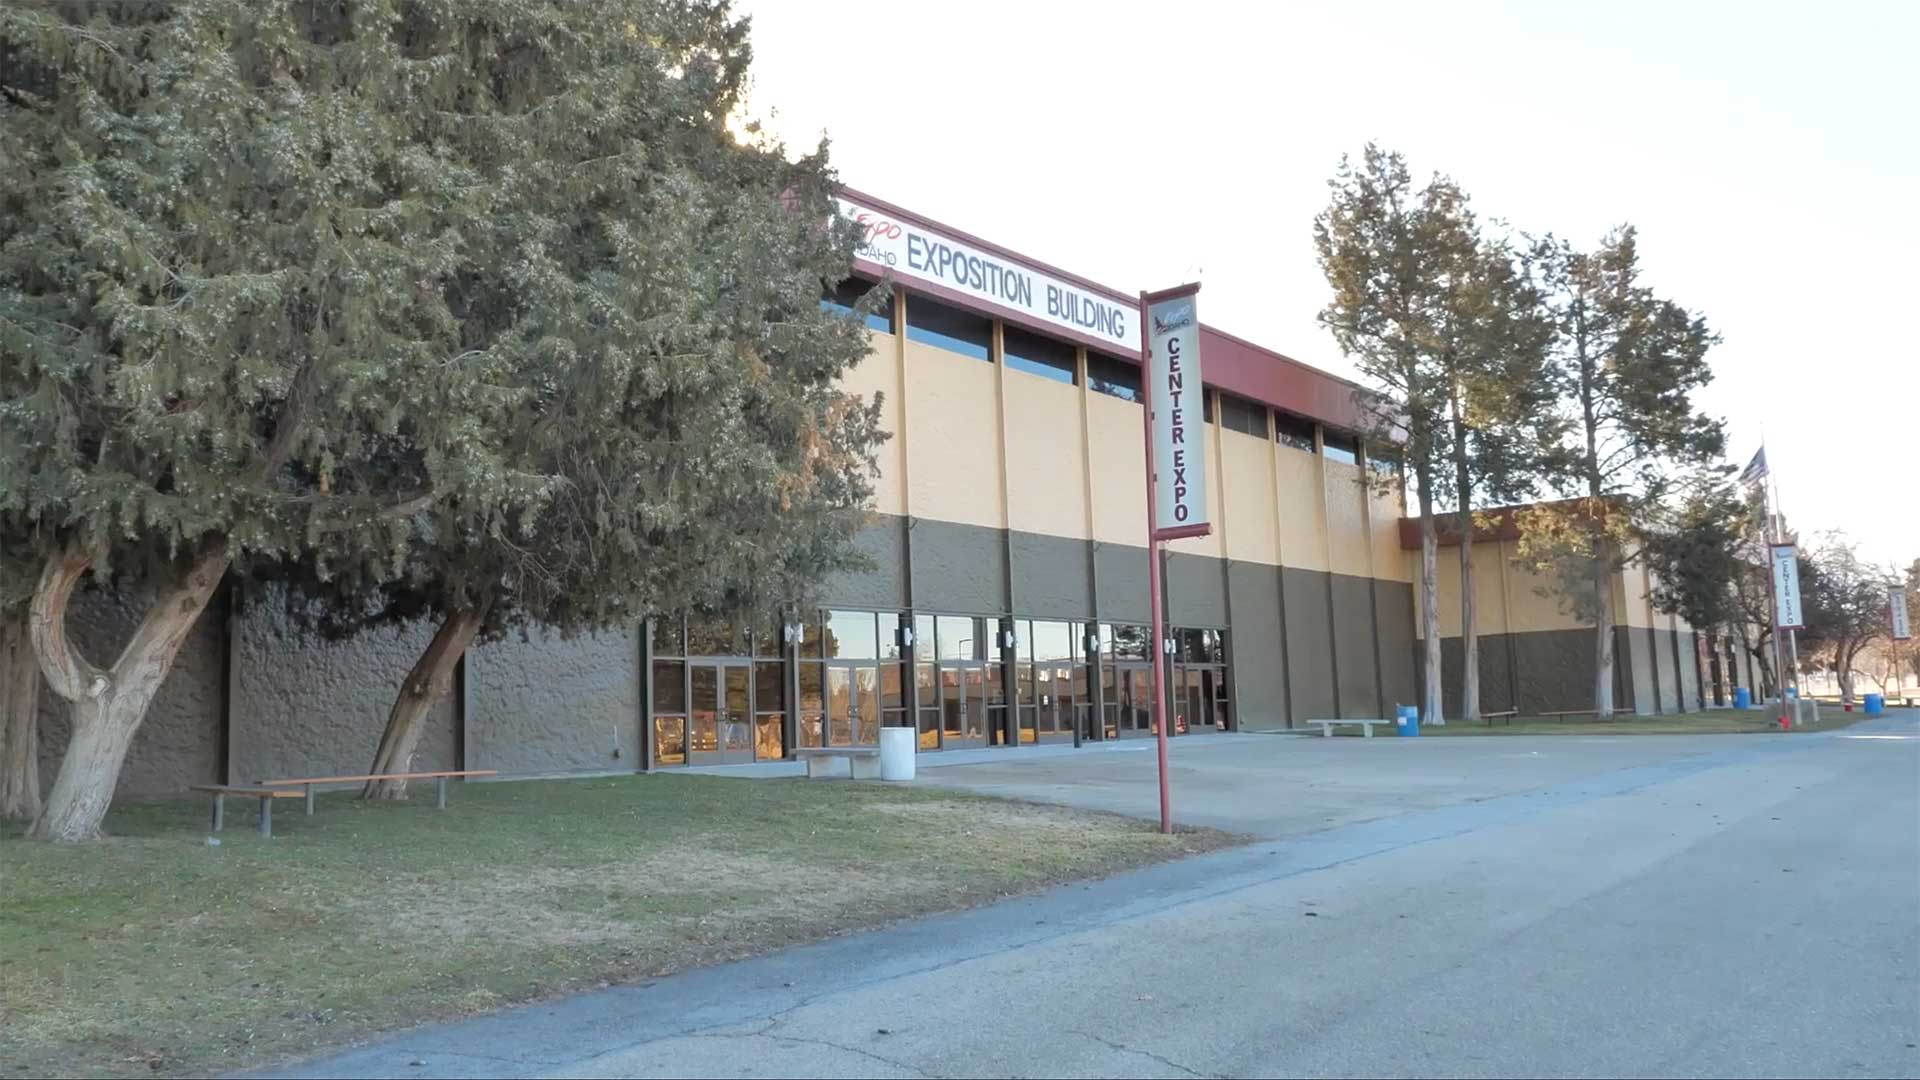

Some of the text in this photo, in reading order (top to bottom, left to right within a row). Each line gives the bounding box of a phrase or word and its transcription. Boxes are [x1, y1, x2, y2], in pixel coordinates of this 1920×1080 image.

[907, 232, 1125, 339] EXPOSITION BUILDING
[1168, 337, 1188, 522] CENTER EXPO
